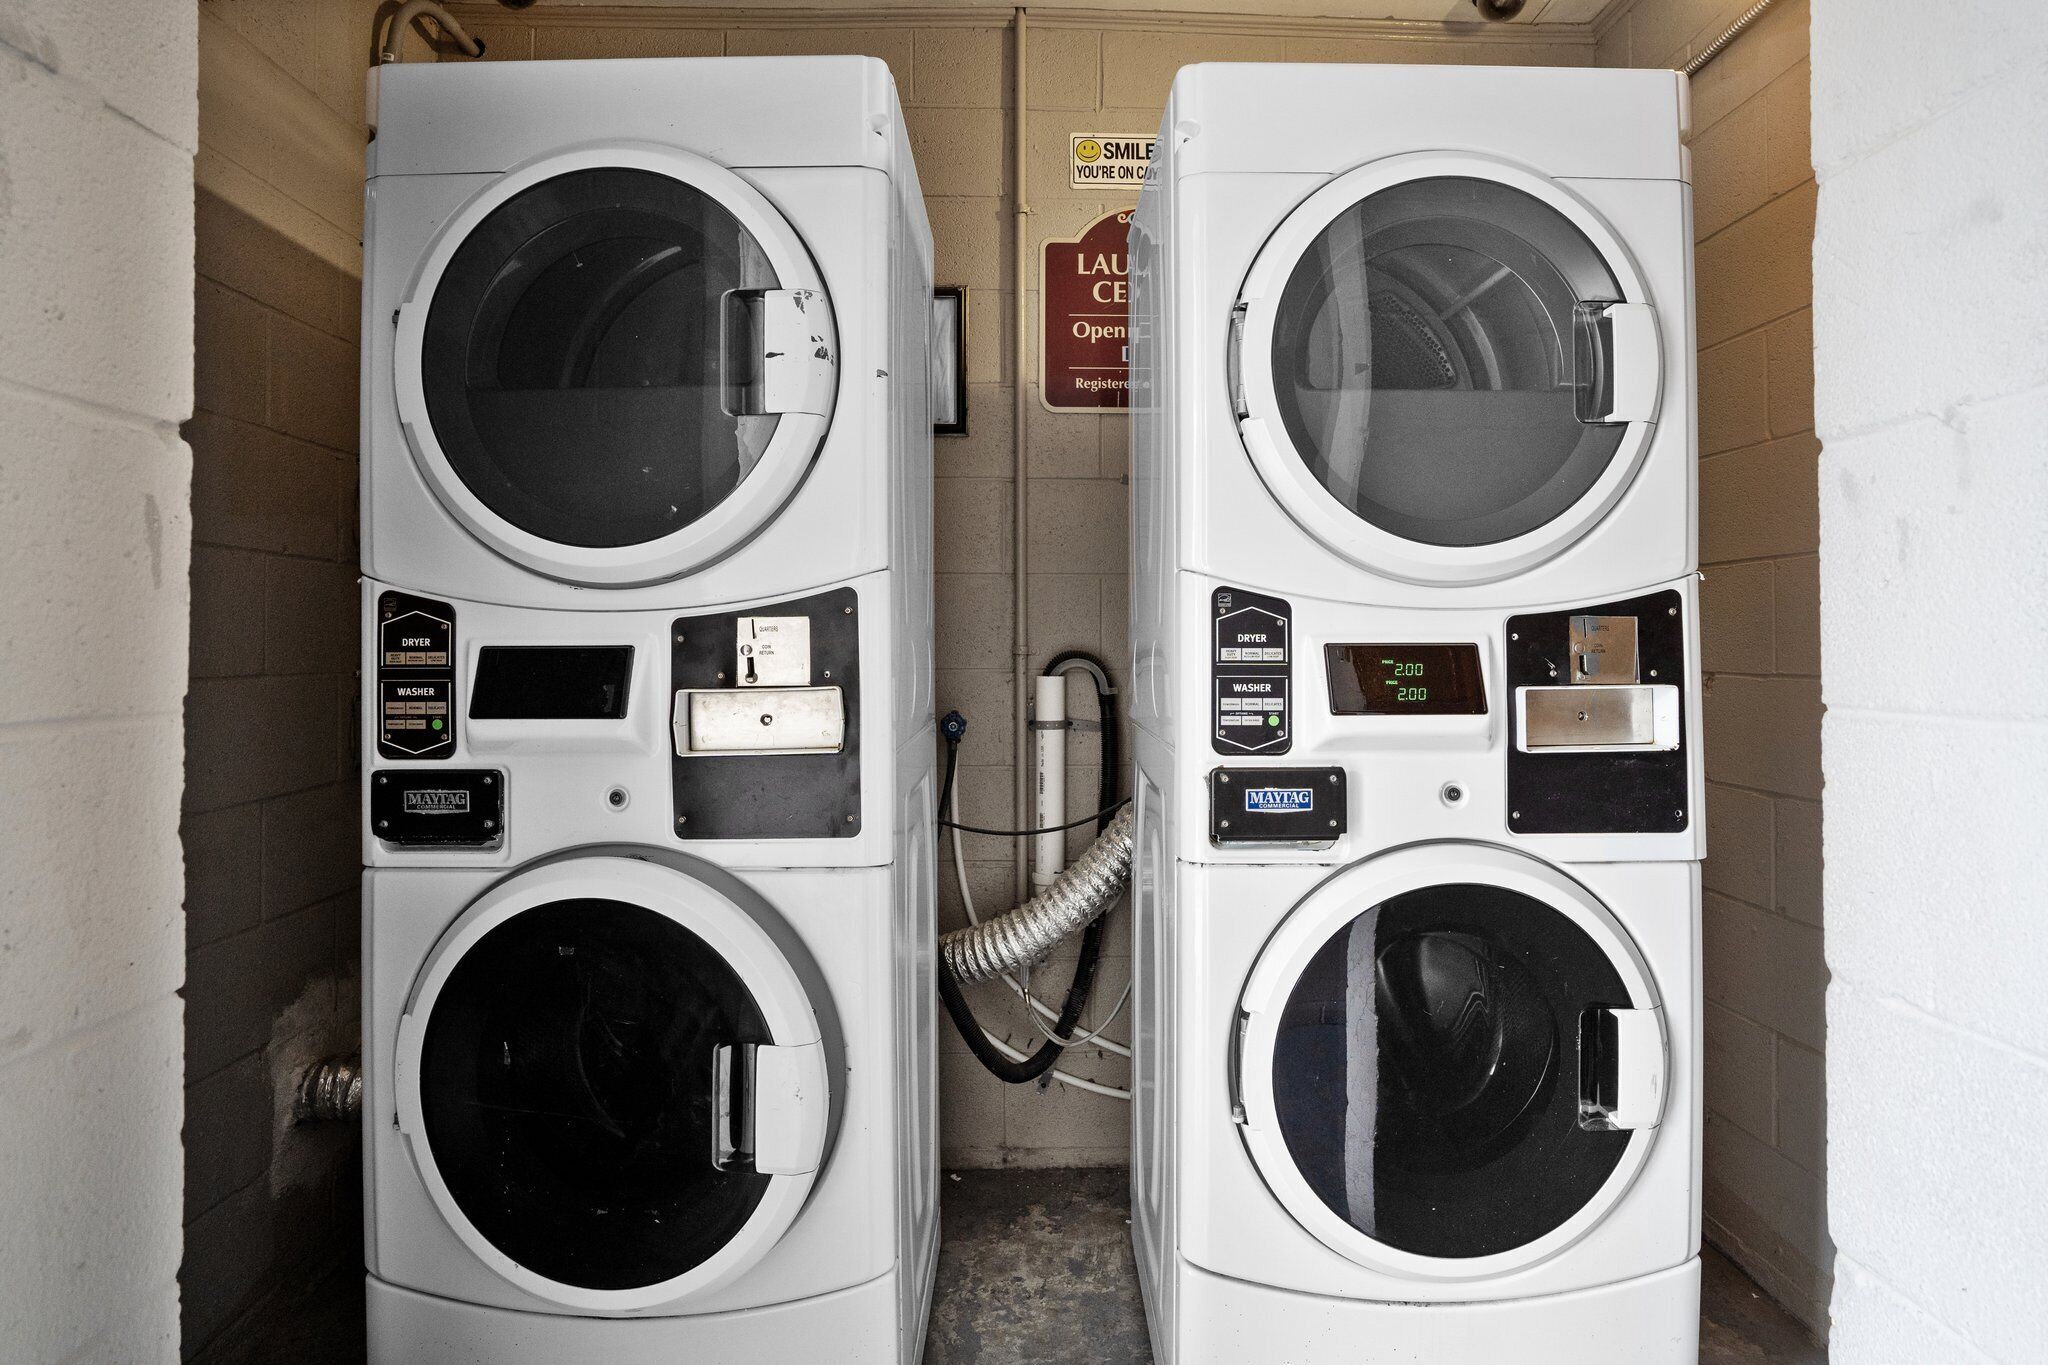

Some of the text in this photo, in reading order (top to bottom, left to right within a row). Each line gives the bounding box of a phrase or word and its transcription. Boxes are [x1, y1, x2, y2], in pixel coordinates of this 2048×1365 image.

[1103, 142, 1155, 160] SMILE
[1076, 165, 1115, 179] YOU'RE
[1118, 165, 1134, 179] ON
[1077, 253, 1130, 275] LAU
[1092, 280, 1127, 303] CE
[1072, 321, 1126, 343] Open
[1075, 377, 1130, 392] Registere
[402, 638, 431, 647] DRYER
[1237, 633, 1267, 643] DRYER
[1394, 663, 1424, 676] 2.00
[397, 687, 435, 696] WASHER
[1232, 683, 1272, 692] WASHER
[1397, 687, 1427, 701] 2.00
[408, 793, 466, 805] MAYTAG
[1249, 791, 1310, 804] MAYTAG
